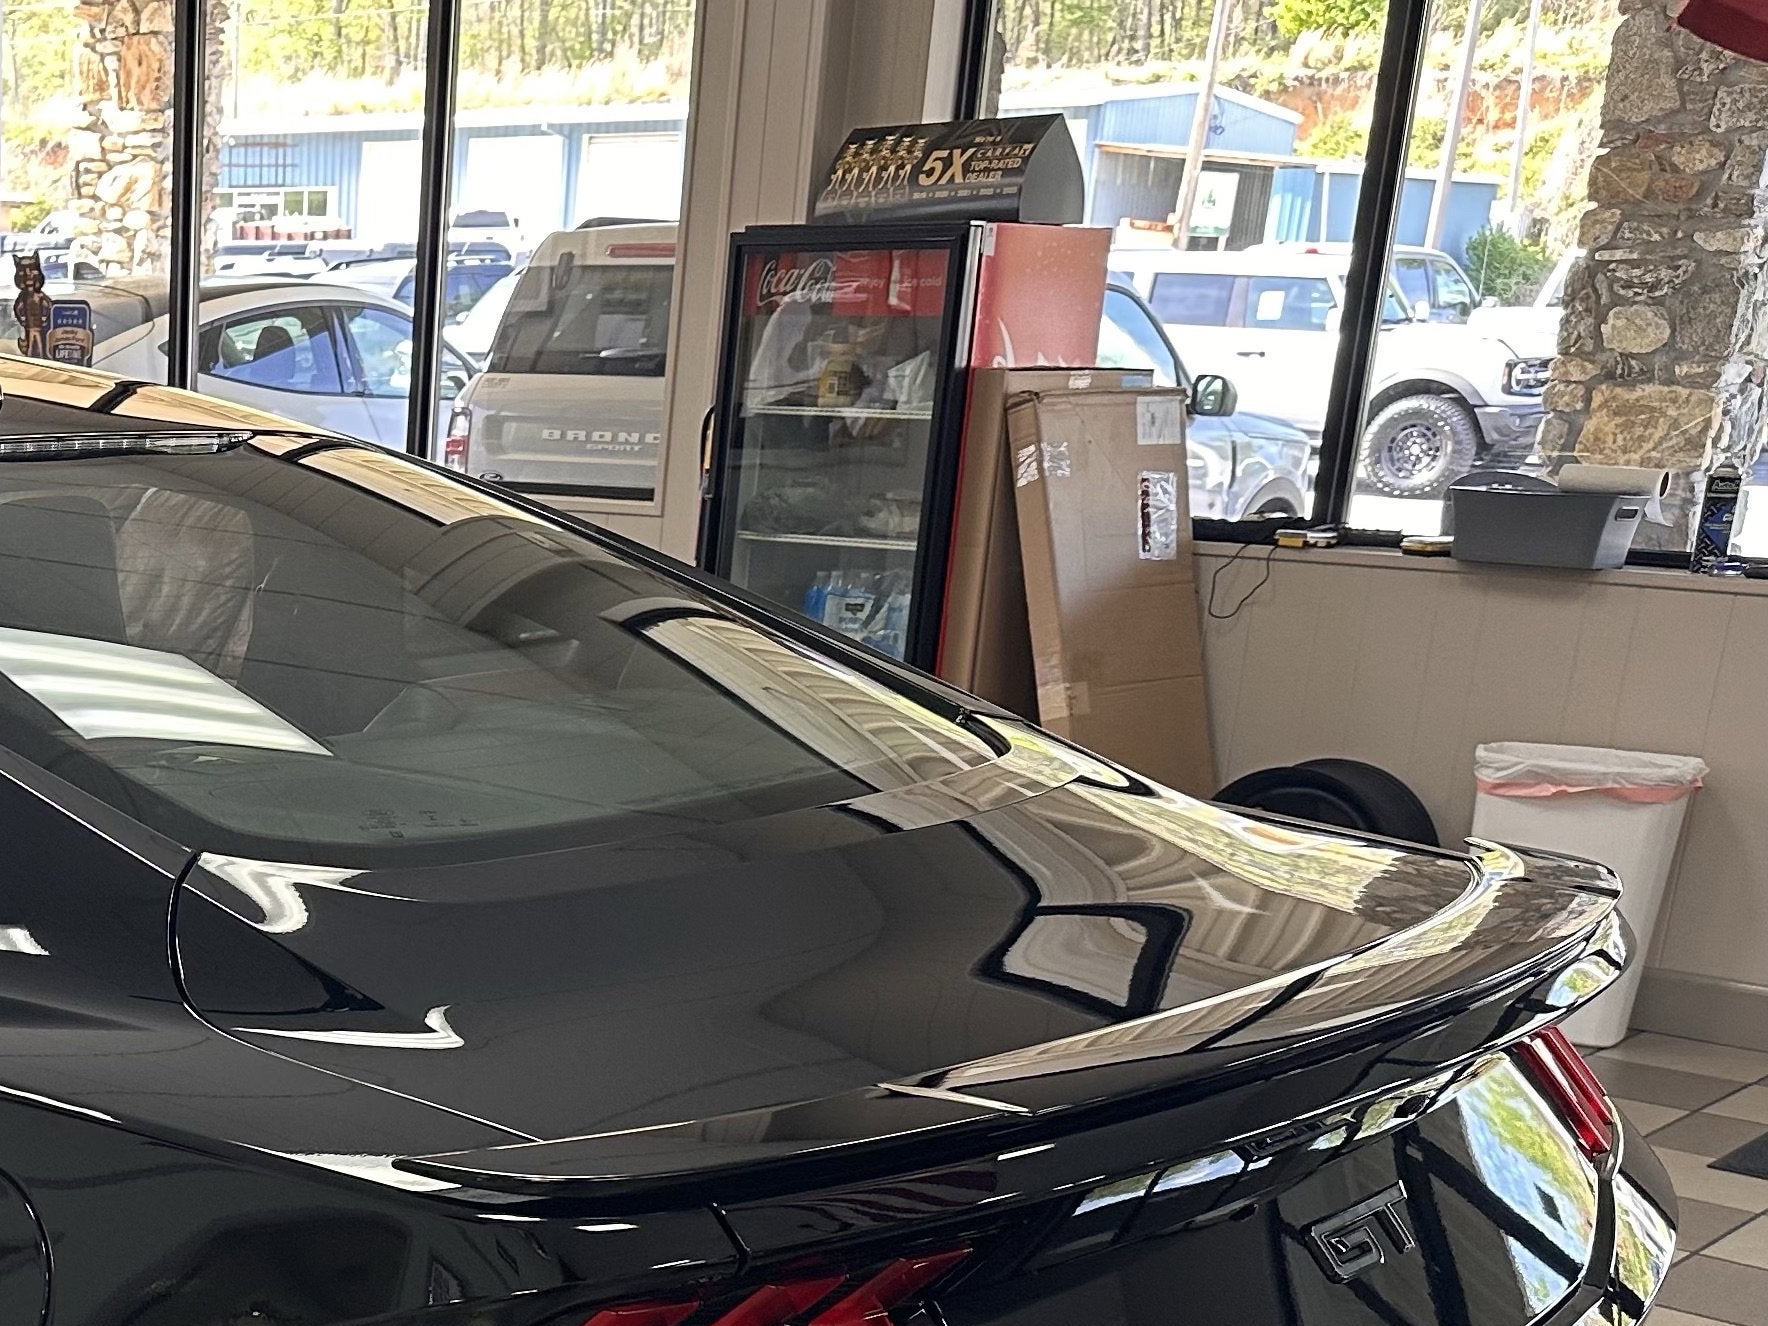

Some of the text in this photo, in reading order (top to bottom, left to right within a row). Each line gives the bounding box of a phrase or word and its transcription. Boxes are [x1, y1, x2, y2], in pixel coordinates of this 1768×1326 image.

[976, 143, 1036, 158] CARFAX
[918, 148, 977, 186] 5X
[969, 158, 1022, 171] TOP-RATED
[964, 170, 1002, 183] DEALER
[542, 429, 661, 444] BRONC
[585, 443, 643, 451] SPORT
[1310, 1179, 1416, 1279] GT
